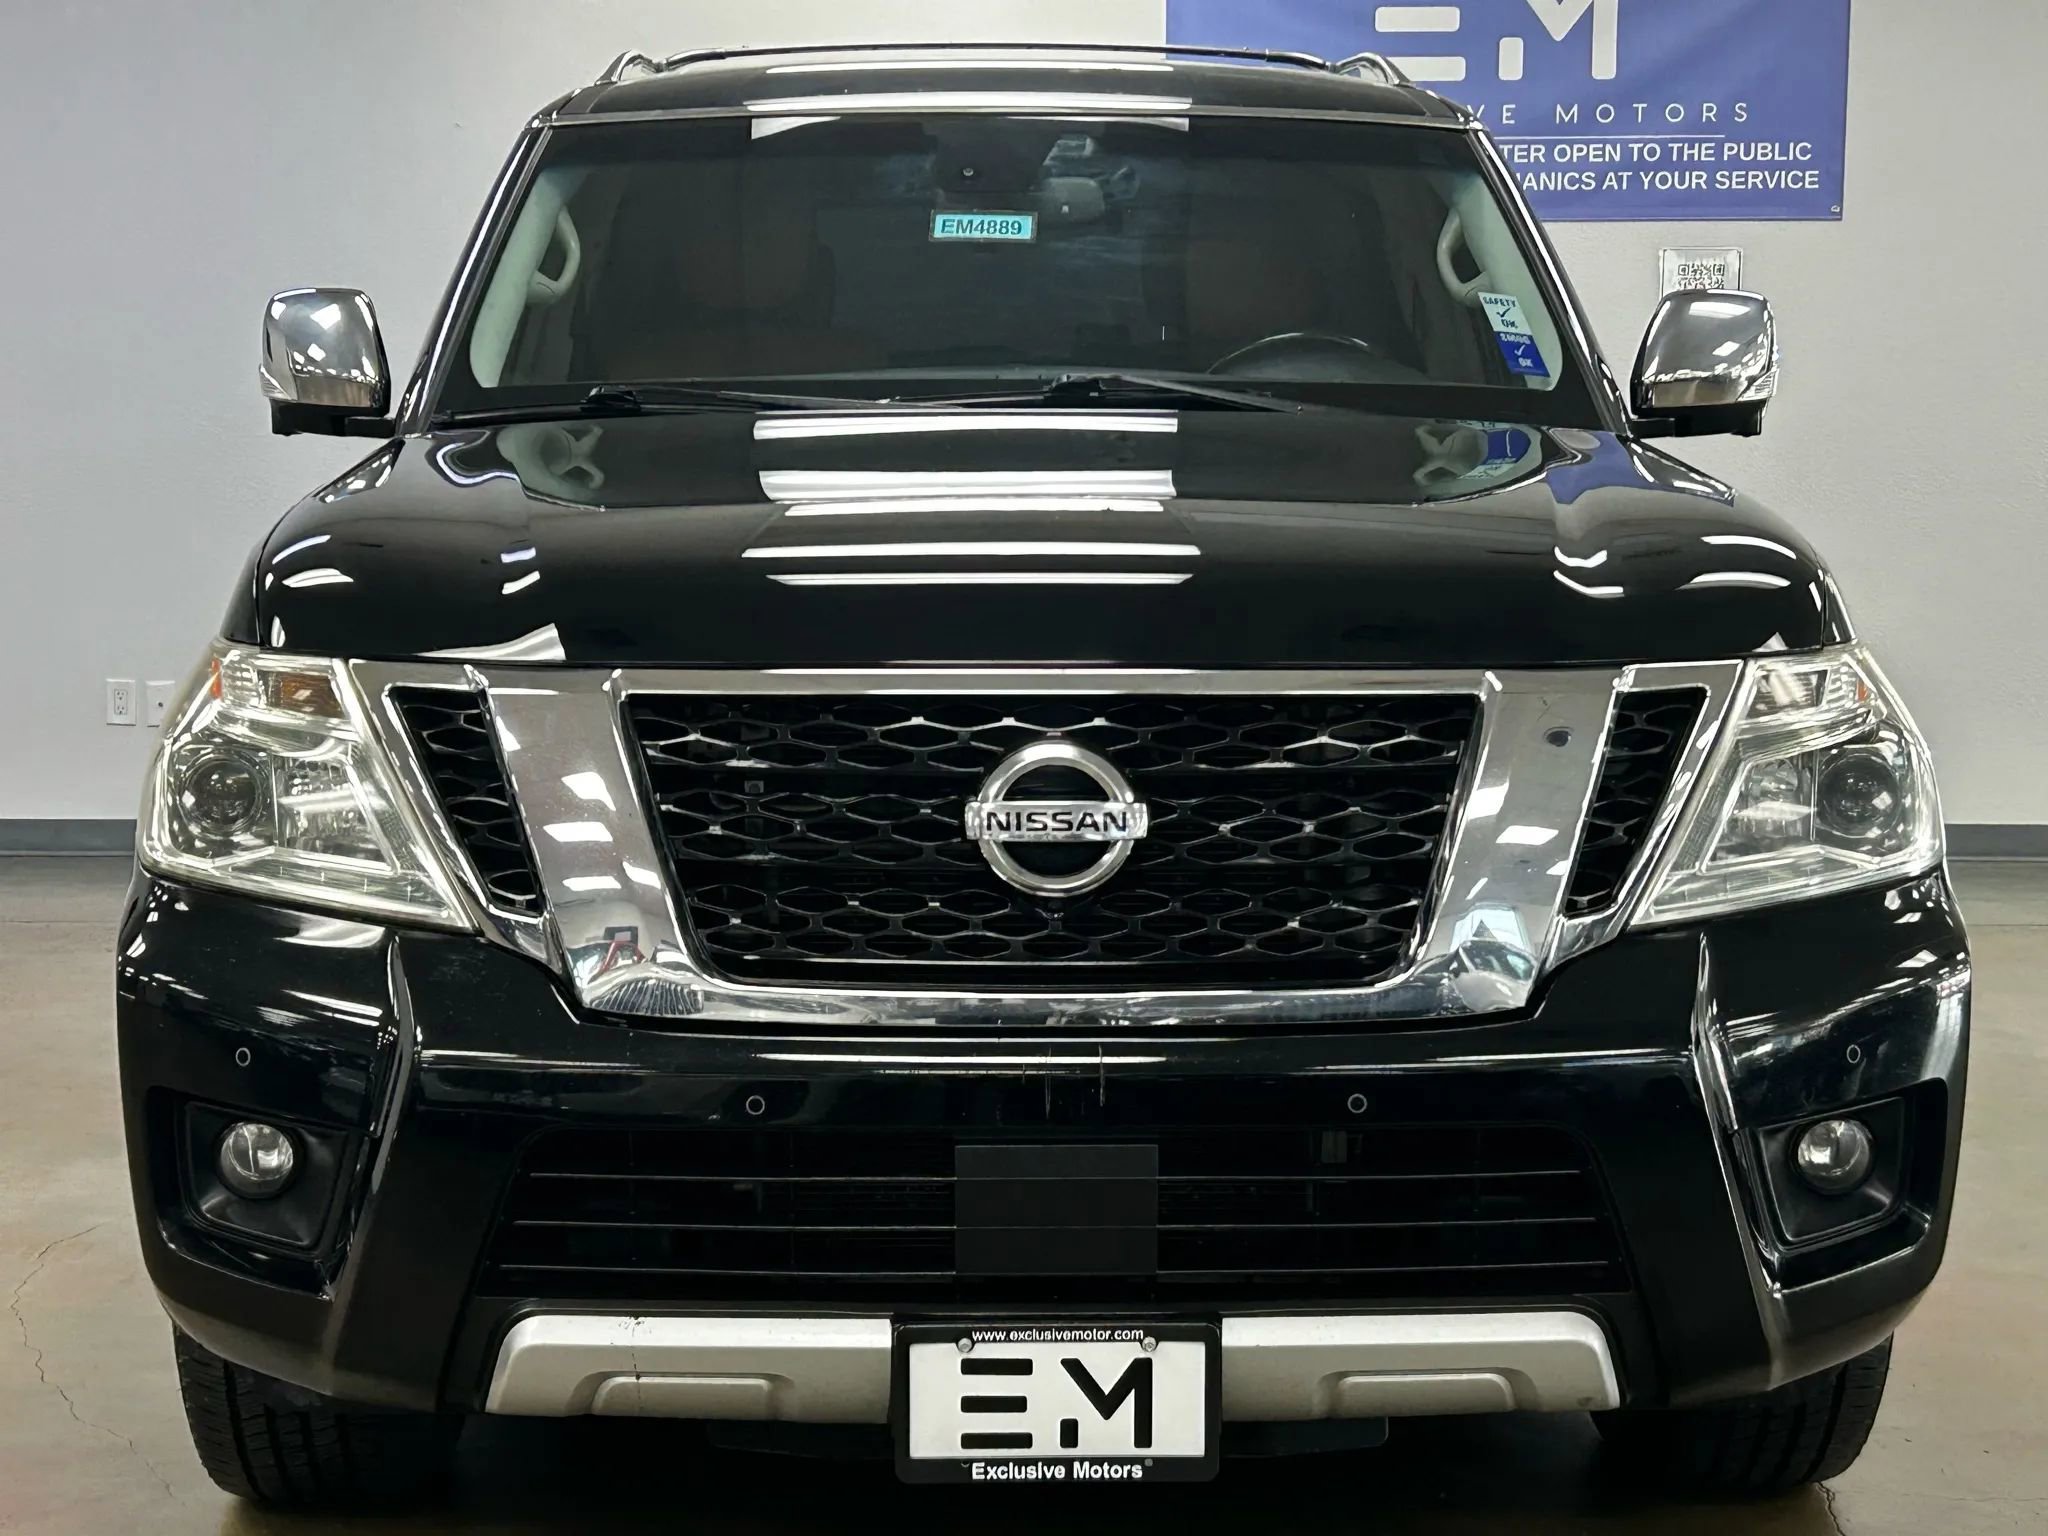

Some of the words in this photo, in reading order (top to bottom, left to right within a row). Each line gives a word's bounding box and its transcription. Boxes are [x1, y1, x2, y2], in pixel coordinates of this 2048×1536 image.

[1556, 103, 1747, 124] MOTORS
[1553, 143, 1621, 163] OPEN
[1628, 143, 1661, 162] TO
[1668, 143, 1715, 161] THE
[1723, 142, 1812, 161] PUBLIC
[1516, 172, 1596, 191] ANICS
[1602, 172, 1632, 190] AT
[1640, 171, 1707, 190] YOUR
[1715, 170, 1819, 190] SERVICE
[941, 219, 1022, 235] EM4889
[986, 811, 1127, 832] NISSAN
[972, 1328, 1144, 1341] www.exclusivemotor.com
[972, 1462, 1065, 1480] Exclusive
[1073, 1461, 1143, 1480] Motors
